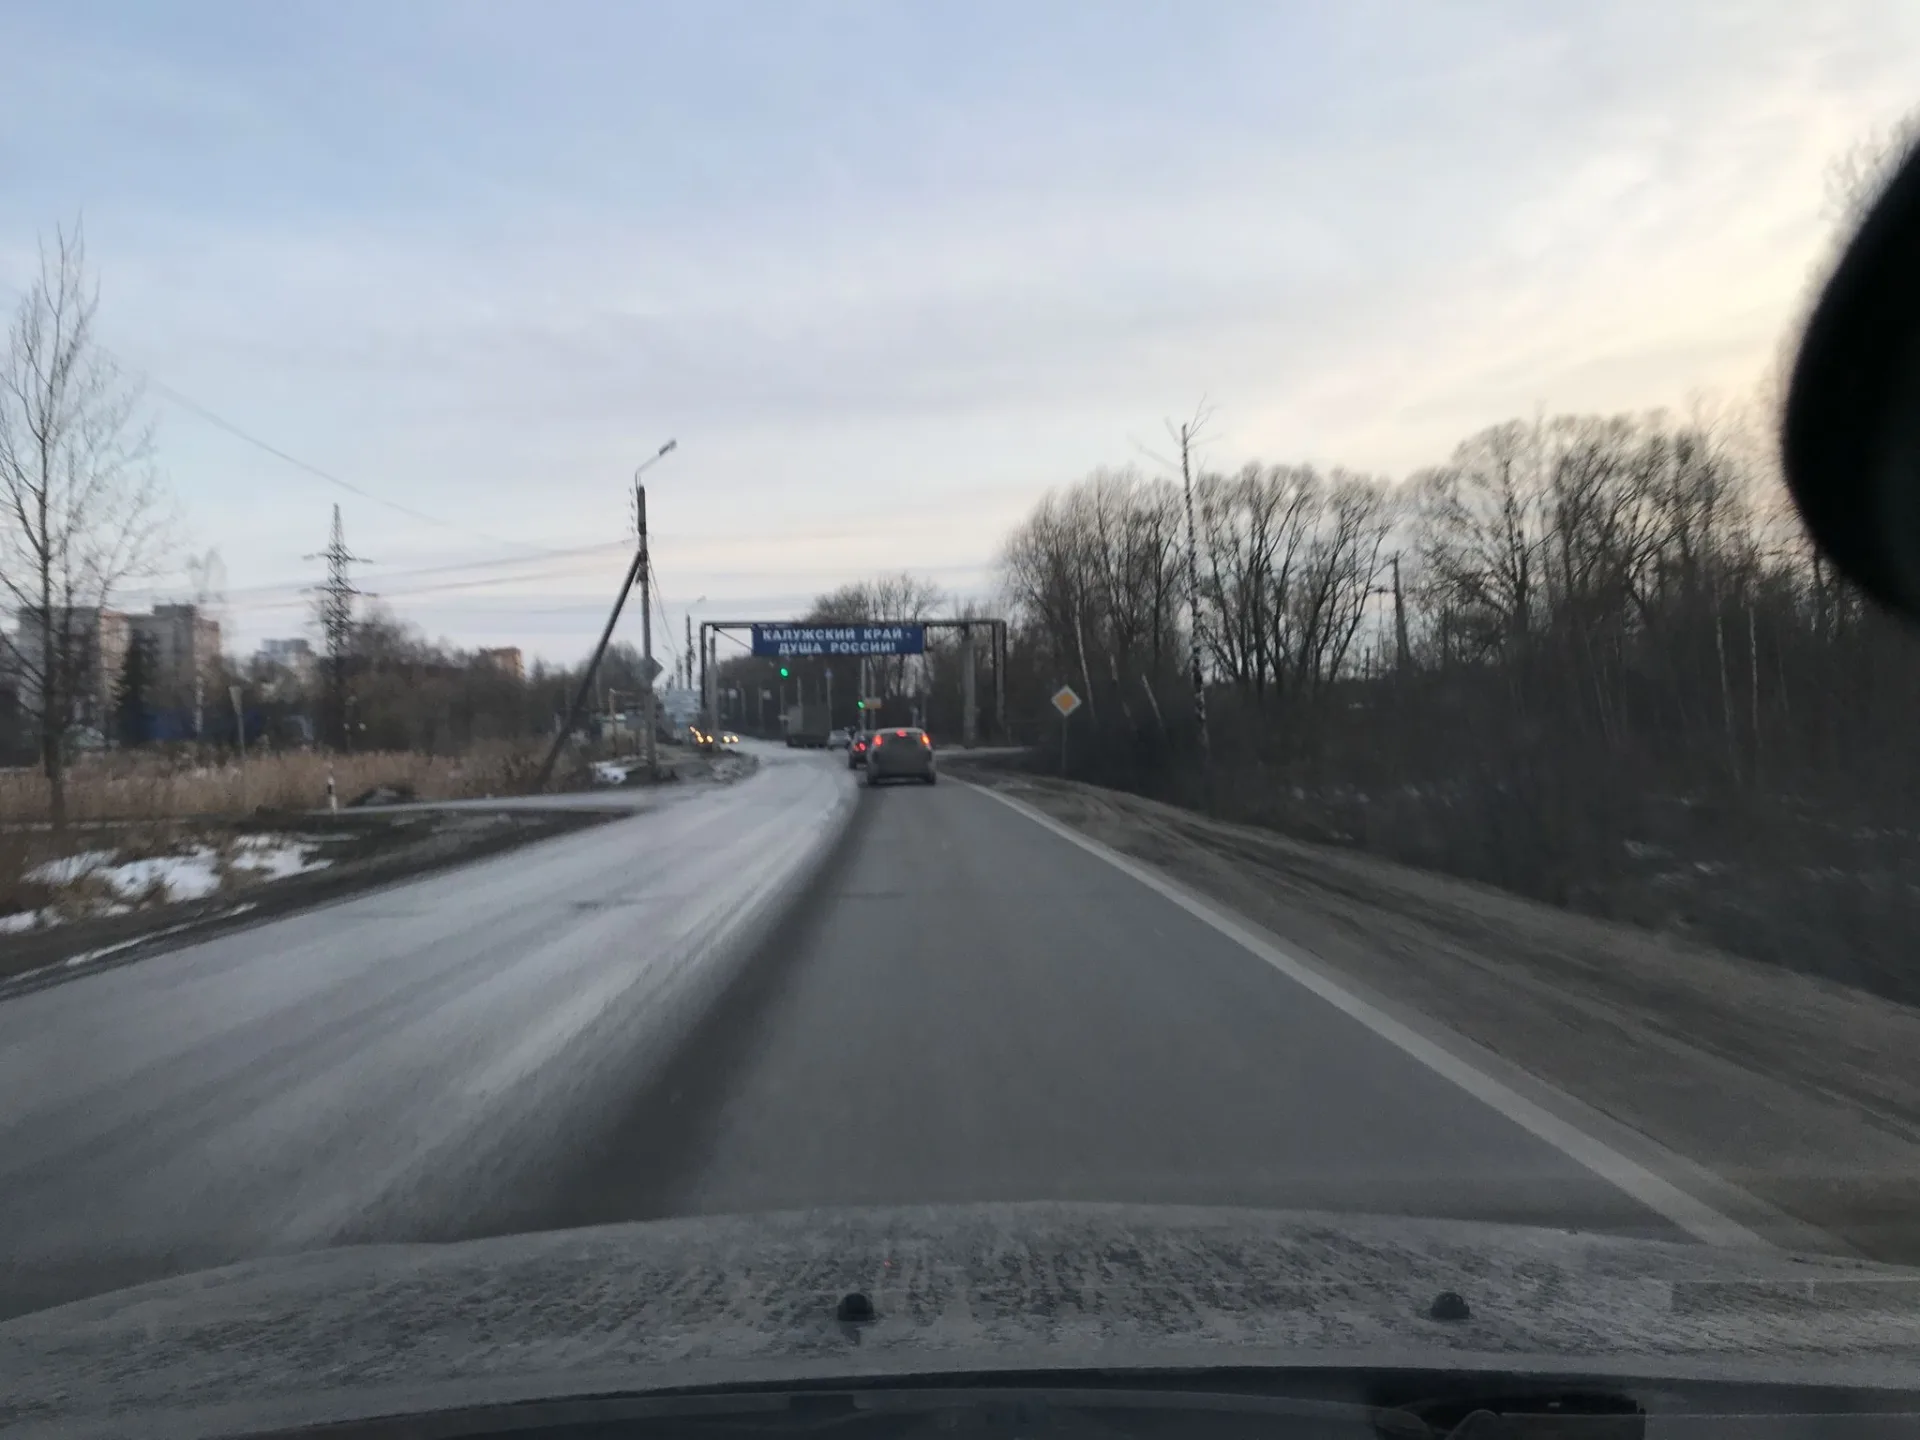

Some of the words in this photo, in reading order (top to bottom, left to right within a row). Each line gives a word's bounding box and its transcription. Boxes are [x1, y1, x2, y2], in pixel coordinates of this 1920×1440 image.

[763, 627, 855, 640] КАЛУЖСКИЙ
[864, 627, 902, 639] КРАЙ
[778, 642, 822, 654] ДУША
[830, 642, 896, 653] РОССИИ!
